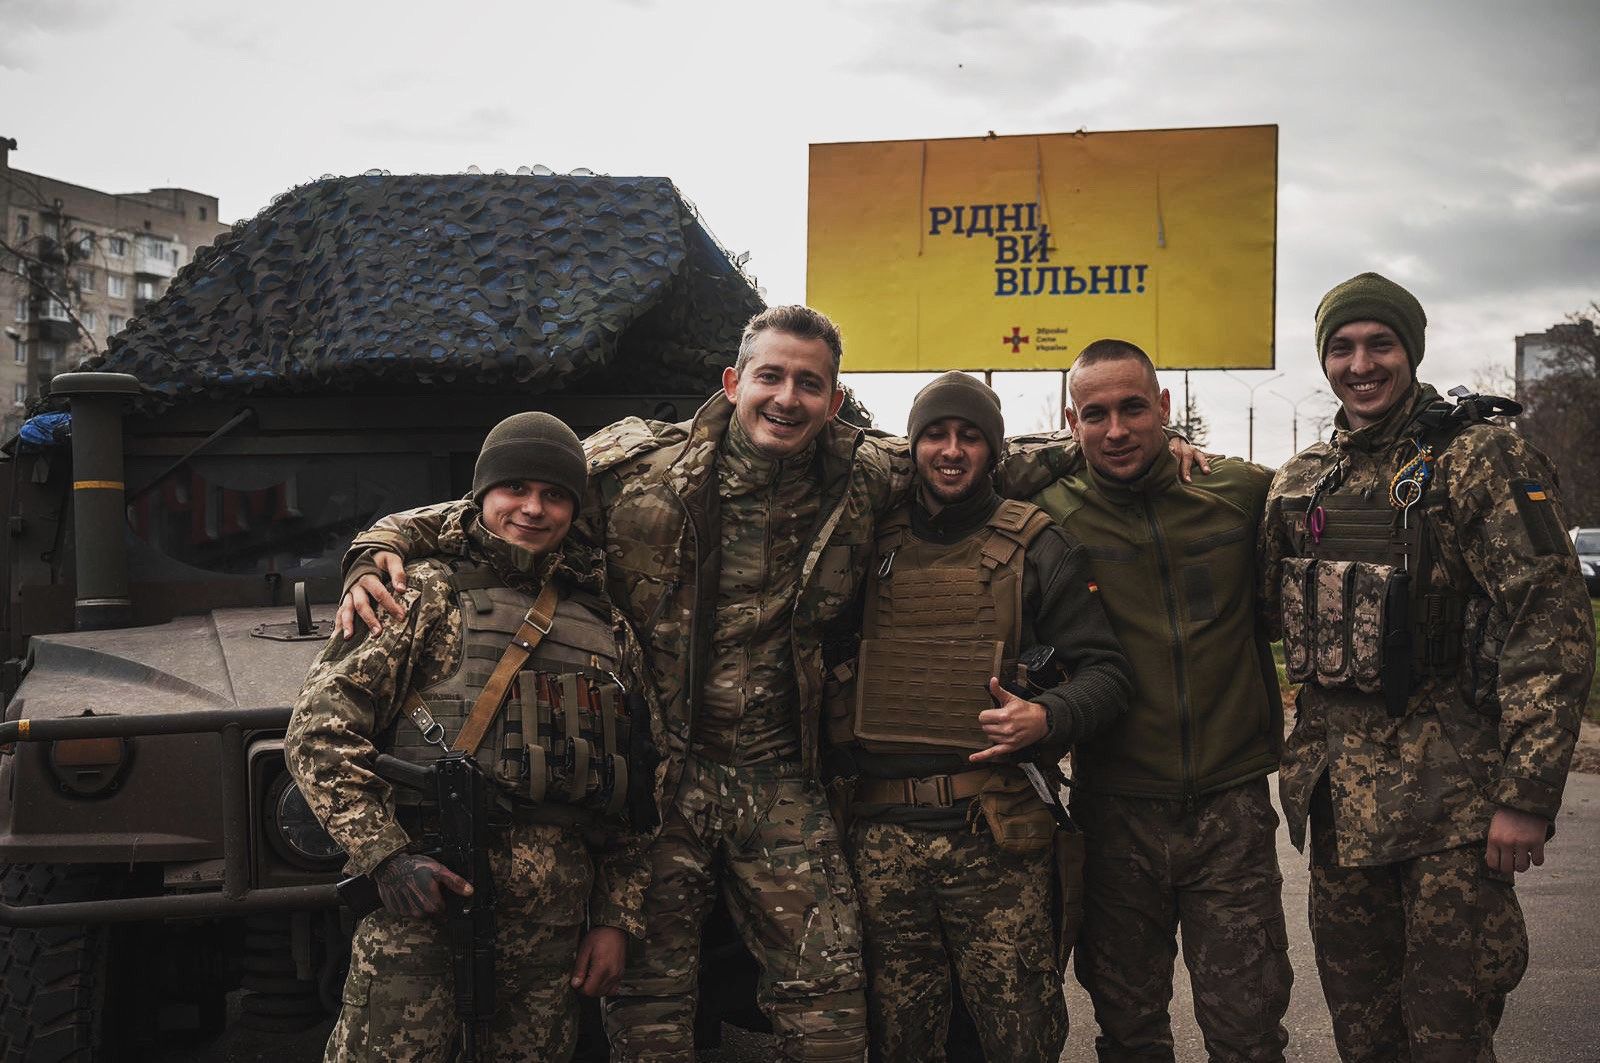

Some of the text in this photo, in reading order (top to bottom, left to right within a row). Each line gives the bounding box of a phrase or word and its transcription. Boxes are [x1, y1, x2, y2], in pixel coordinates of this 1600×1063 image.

[929, 202, 1047, 238] РІДНІ,
[995, 233, 1050, 264] ВИ
[994, 264, 1148, 296] ВІЛЬНІ!
